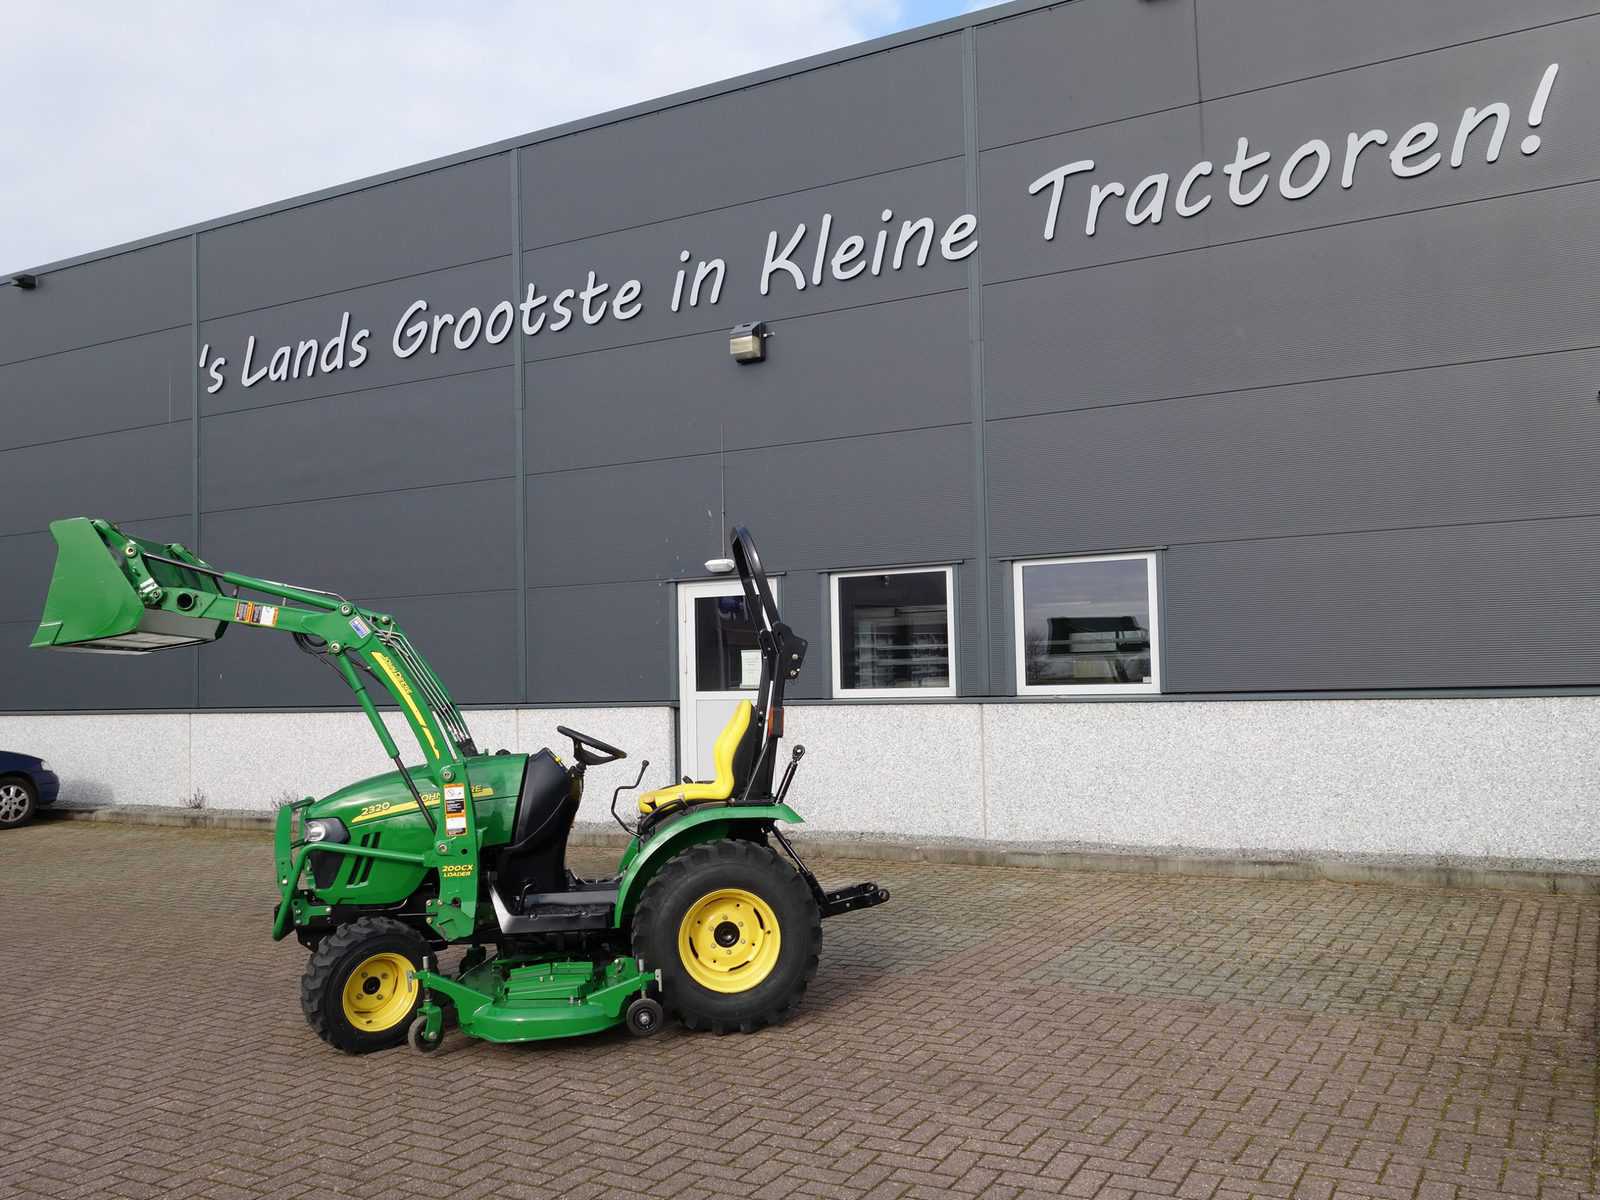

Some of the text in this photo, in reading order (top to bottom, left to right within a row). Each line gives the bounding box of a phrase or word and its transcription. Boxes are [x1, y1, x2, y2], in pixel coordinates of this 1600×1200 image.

[199, 63, 1560, 394] 's Lands Grootste in Kleine Tractoren!
[360, 801, 391, 817] 2320
[442, 864, 474, 872] 200CX
